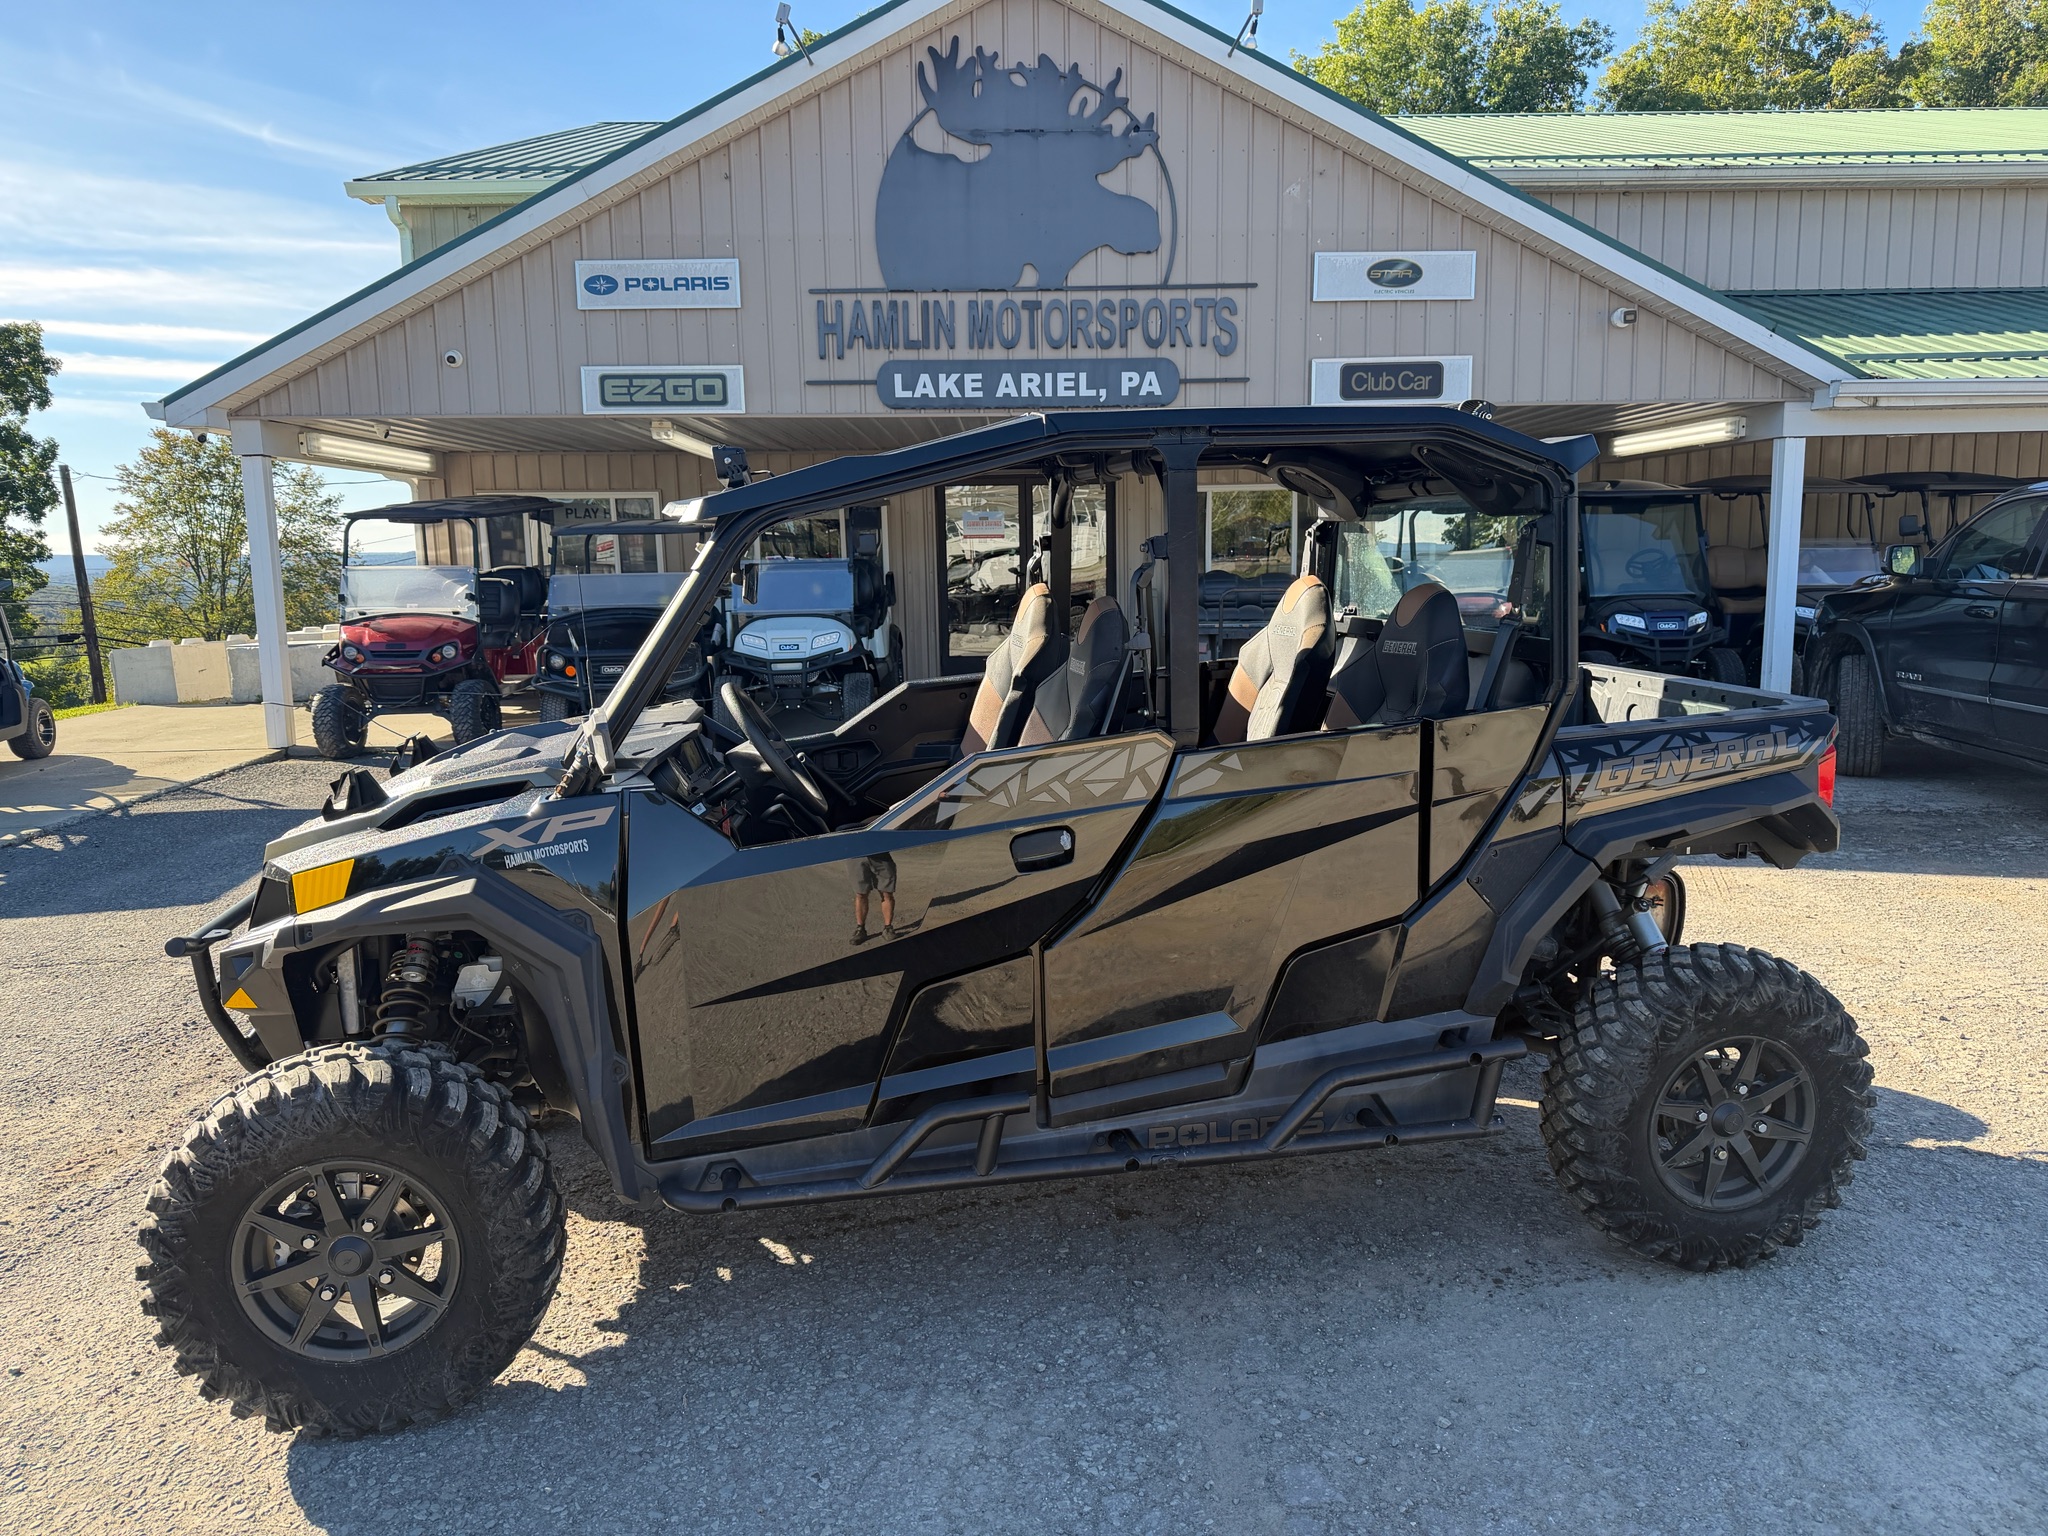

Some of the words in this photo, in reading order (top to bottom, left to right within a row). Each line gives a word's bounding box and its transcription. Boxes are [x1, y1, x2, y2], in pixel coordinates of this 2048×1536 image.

[624, 276, 730, 292] POLARIS
[816, 299, 955, 360] HAMLIN
[968, 297, 1238, 356] MOTORSPORTS
[893, 372, 983, 399] LAKE
[995, 371, 1107, 403] ARIEL,
[1121, 371, 1162, 396] PA
[1351, 371, 1396, 392] Club
[1398, 370, 1432, 390] Car
[565, 507, 599, 519] PLAY
[1382, 640, 1418, 655] GENERAL
[1895, 670, 1922, 681] RAM
[1594, 730, 1803, 791] GENERAL
[470, 806, 616, 858] XP
[504, 853, 534, 869] HAMLIN
[534, 838, 589, 861] MOTORSPORTS
[1148, 1111, 1325, 1148] POLAS
